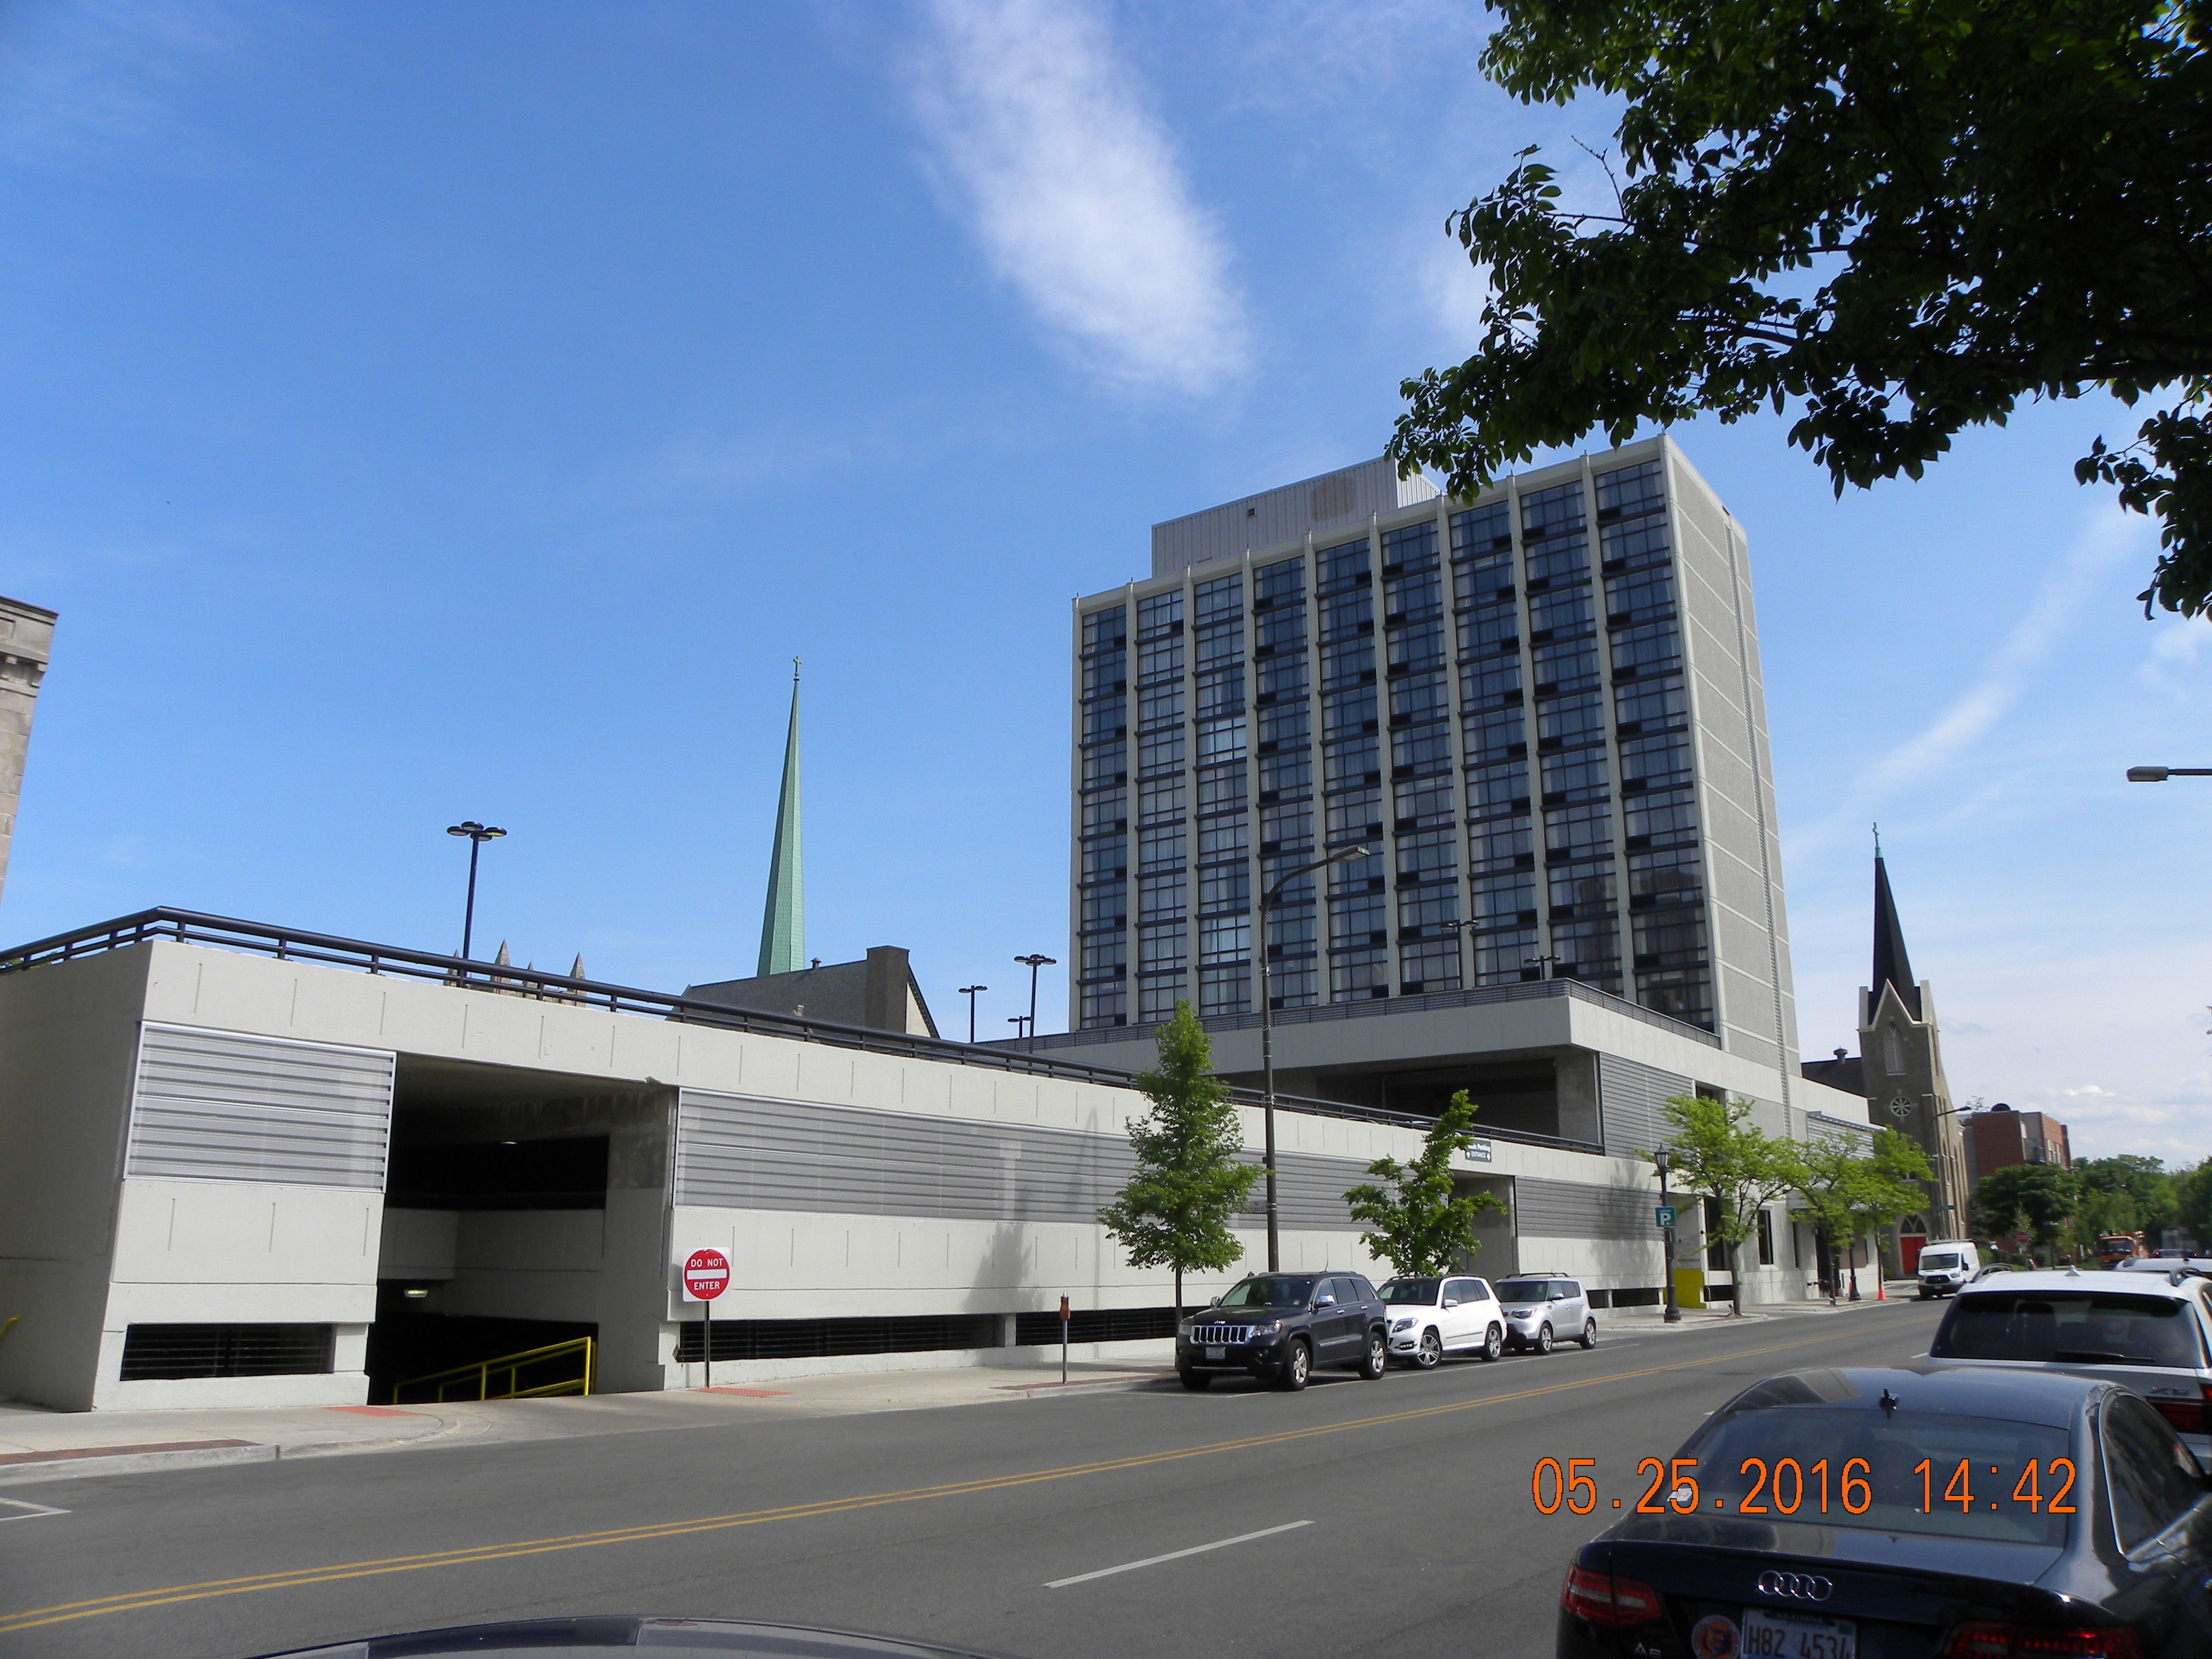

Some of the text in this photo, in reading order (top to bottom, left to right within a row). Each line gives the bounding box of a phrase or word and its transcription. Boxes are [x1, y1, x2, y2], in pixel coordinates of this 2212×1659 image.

[1471, 1150, 1486, 1158] ENTRANCE
[1660, 1212, 1671, 1226] P
[691, 1258, 723, 1267] DO NOT
[694, 1281, 720, 1290] ENTER
[1748, 1624, 1786, 1658] H82
